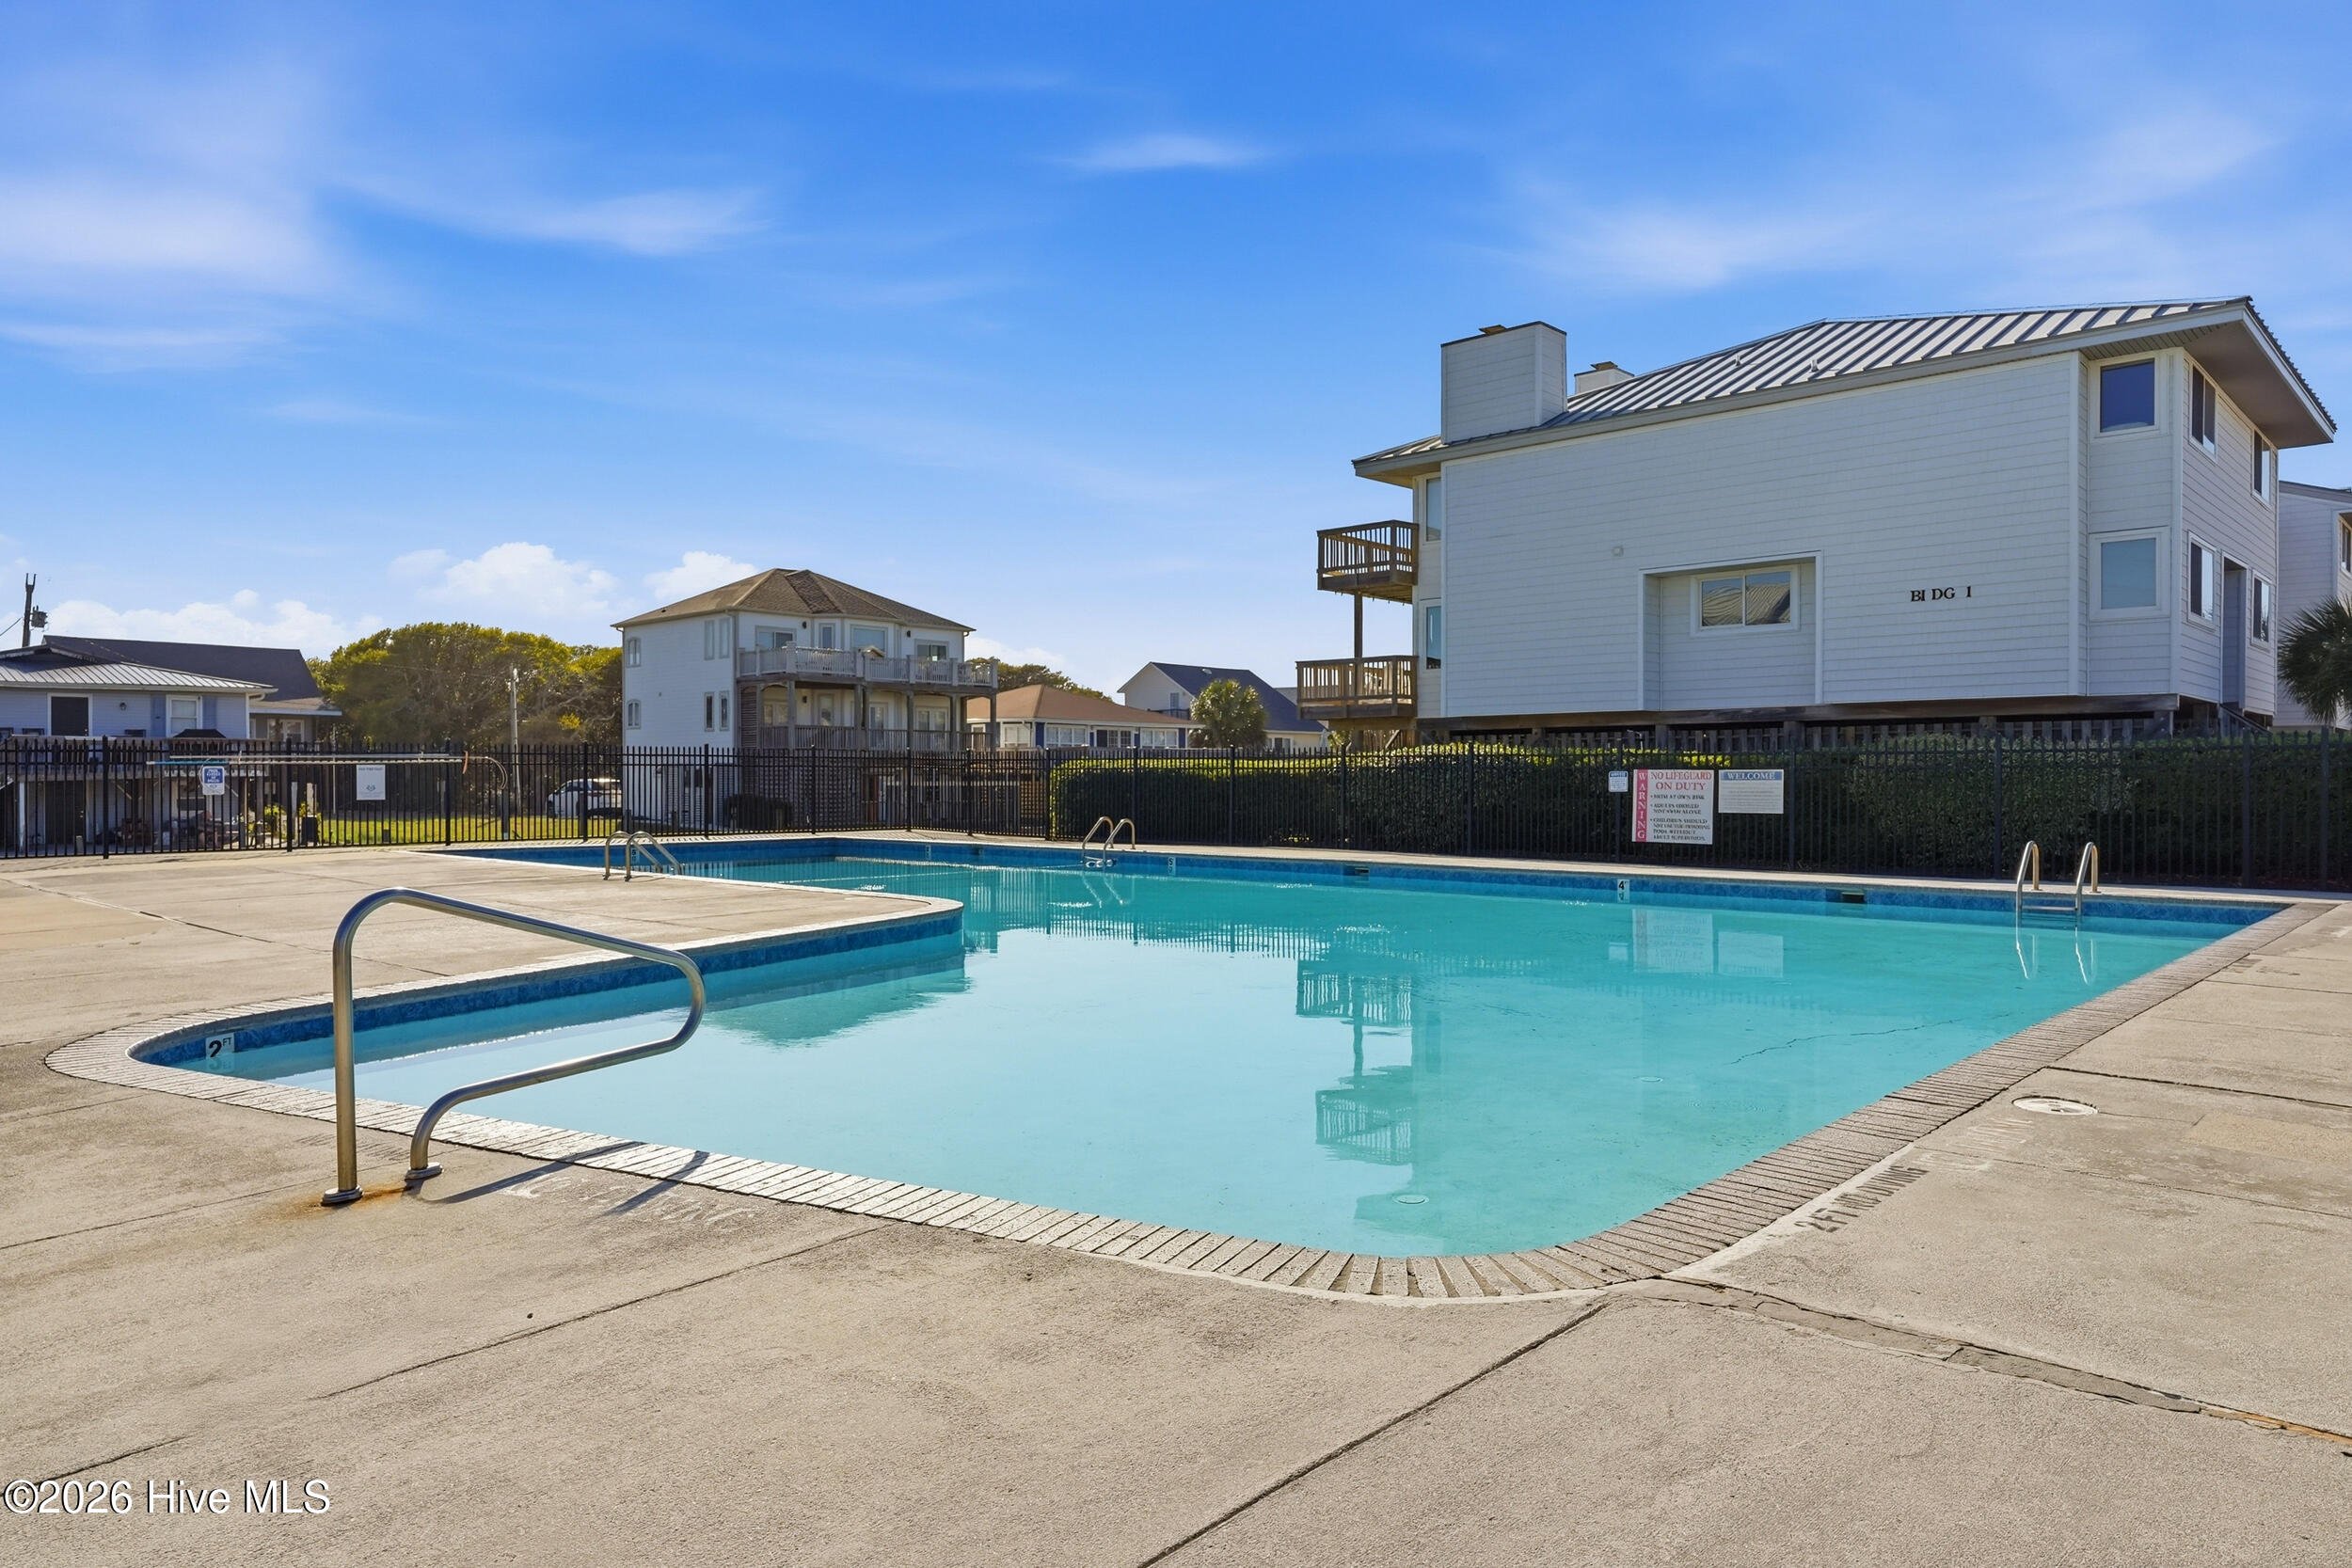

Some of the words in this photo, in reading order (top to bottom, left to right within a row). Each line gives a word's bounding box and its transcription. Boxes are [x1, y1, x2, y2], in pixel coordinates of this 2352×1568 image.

[1651, 771, 1663, 780] NO
[1665, 771, 1712, 780] LIFEGUARD
[1656, 782, 1672, 790] ON
[1638, 772, 1647, 839] WARNING
